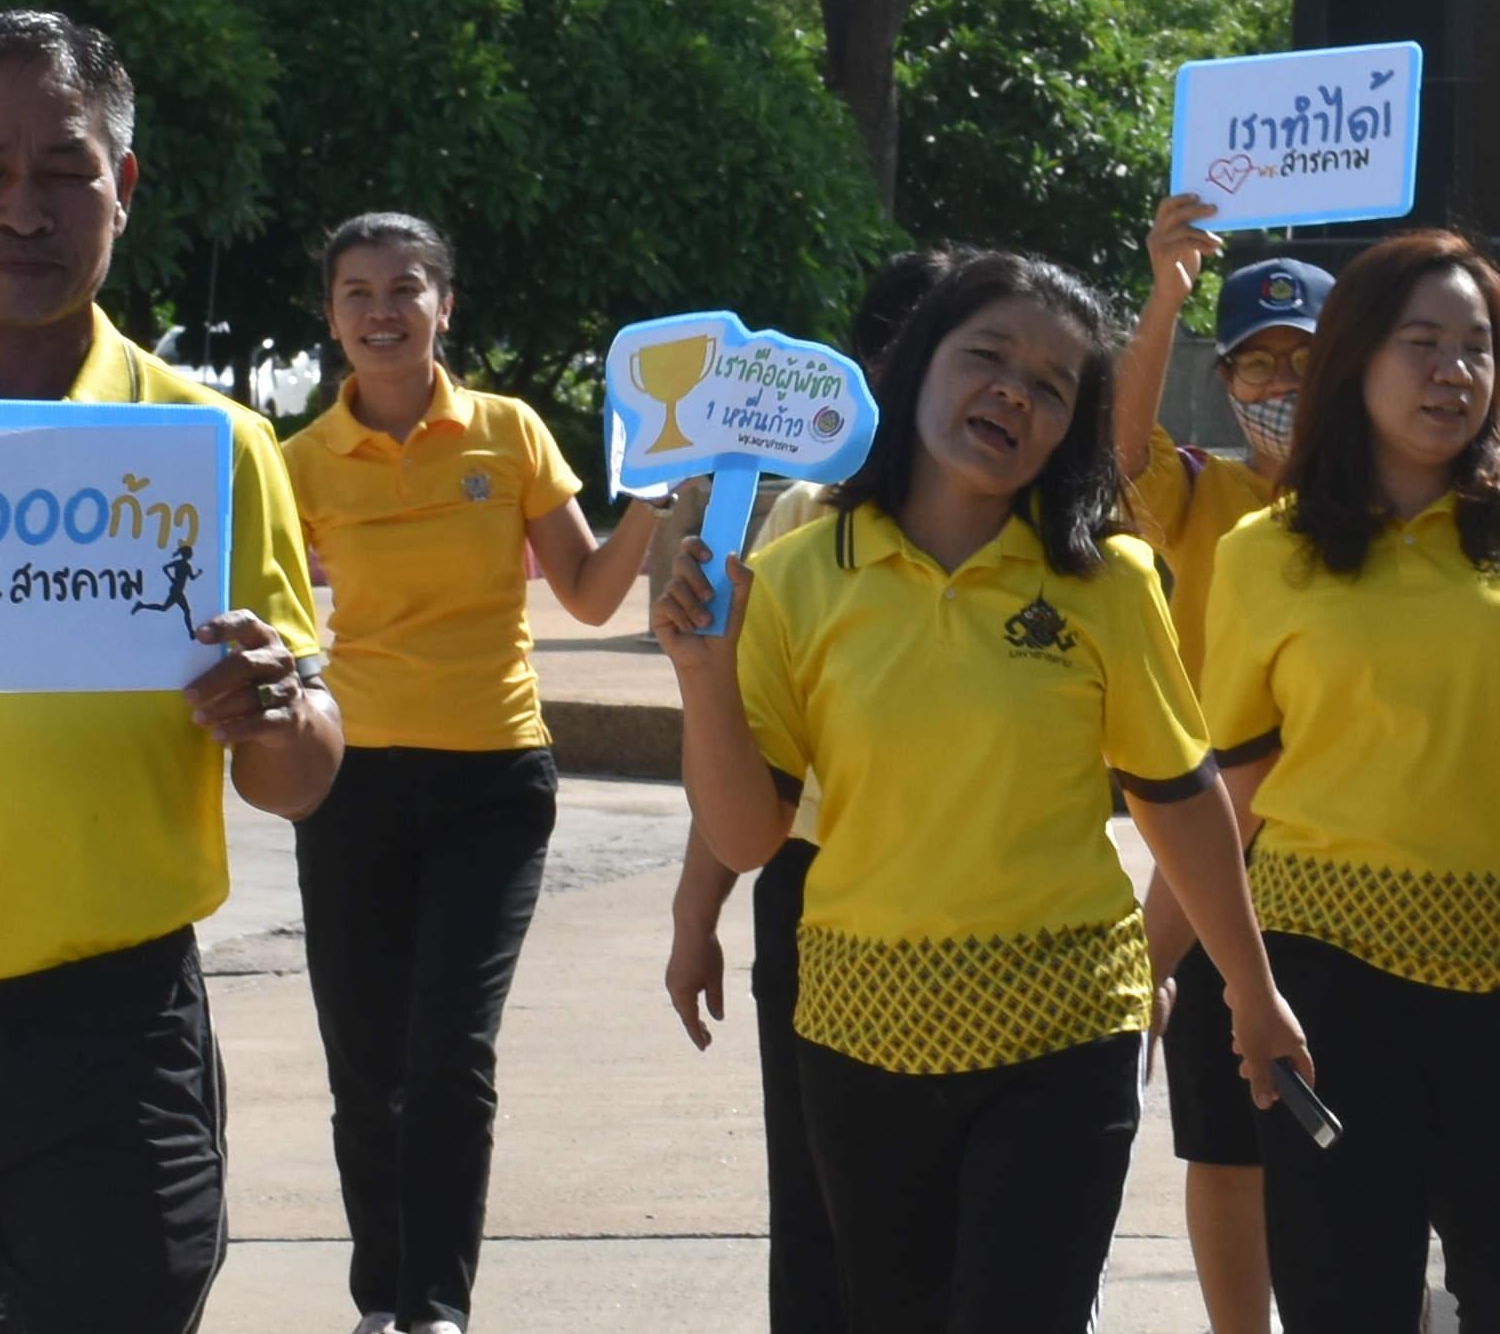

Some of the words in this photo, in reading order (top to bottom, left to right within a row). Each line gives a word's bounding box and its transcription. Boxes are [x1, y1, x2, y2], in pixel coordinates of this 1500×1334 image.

[715, 347, 842, 401] เราคือผู้พิชิต
[706, 400, 715, 420] 1
[722, 387, 804, 438] หมื่นก้าว
